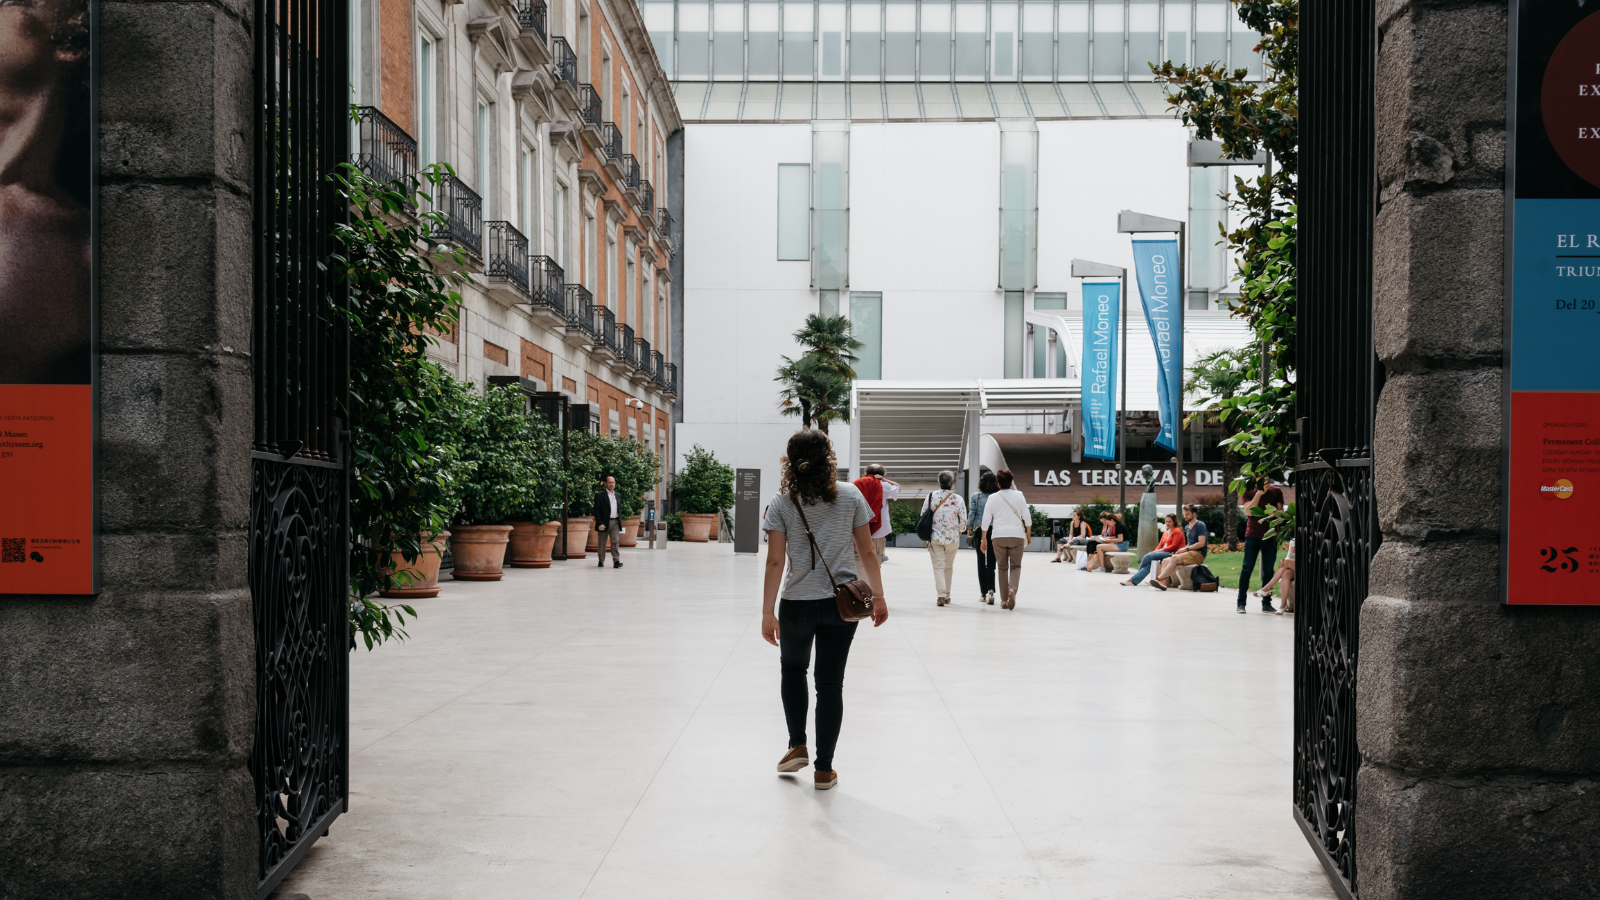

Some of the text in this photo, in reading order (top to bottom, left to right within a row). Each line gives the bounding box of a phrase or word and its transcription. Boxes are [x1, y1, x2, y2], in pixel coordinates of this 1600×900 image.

[1556, 234, 1580, 248] EL
[1151, 254, 1169, 313] Moneo
[1555, 298, 1595, 310] Del 20
[1094, 294, 1109, 345] Moneo
[1091, 348, 1107, 394] Rafael
[1034, 470, 1071, 486] LAS
[1540, 546, 1579, 573] 25
